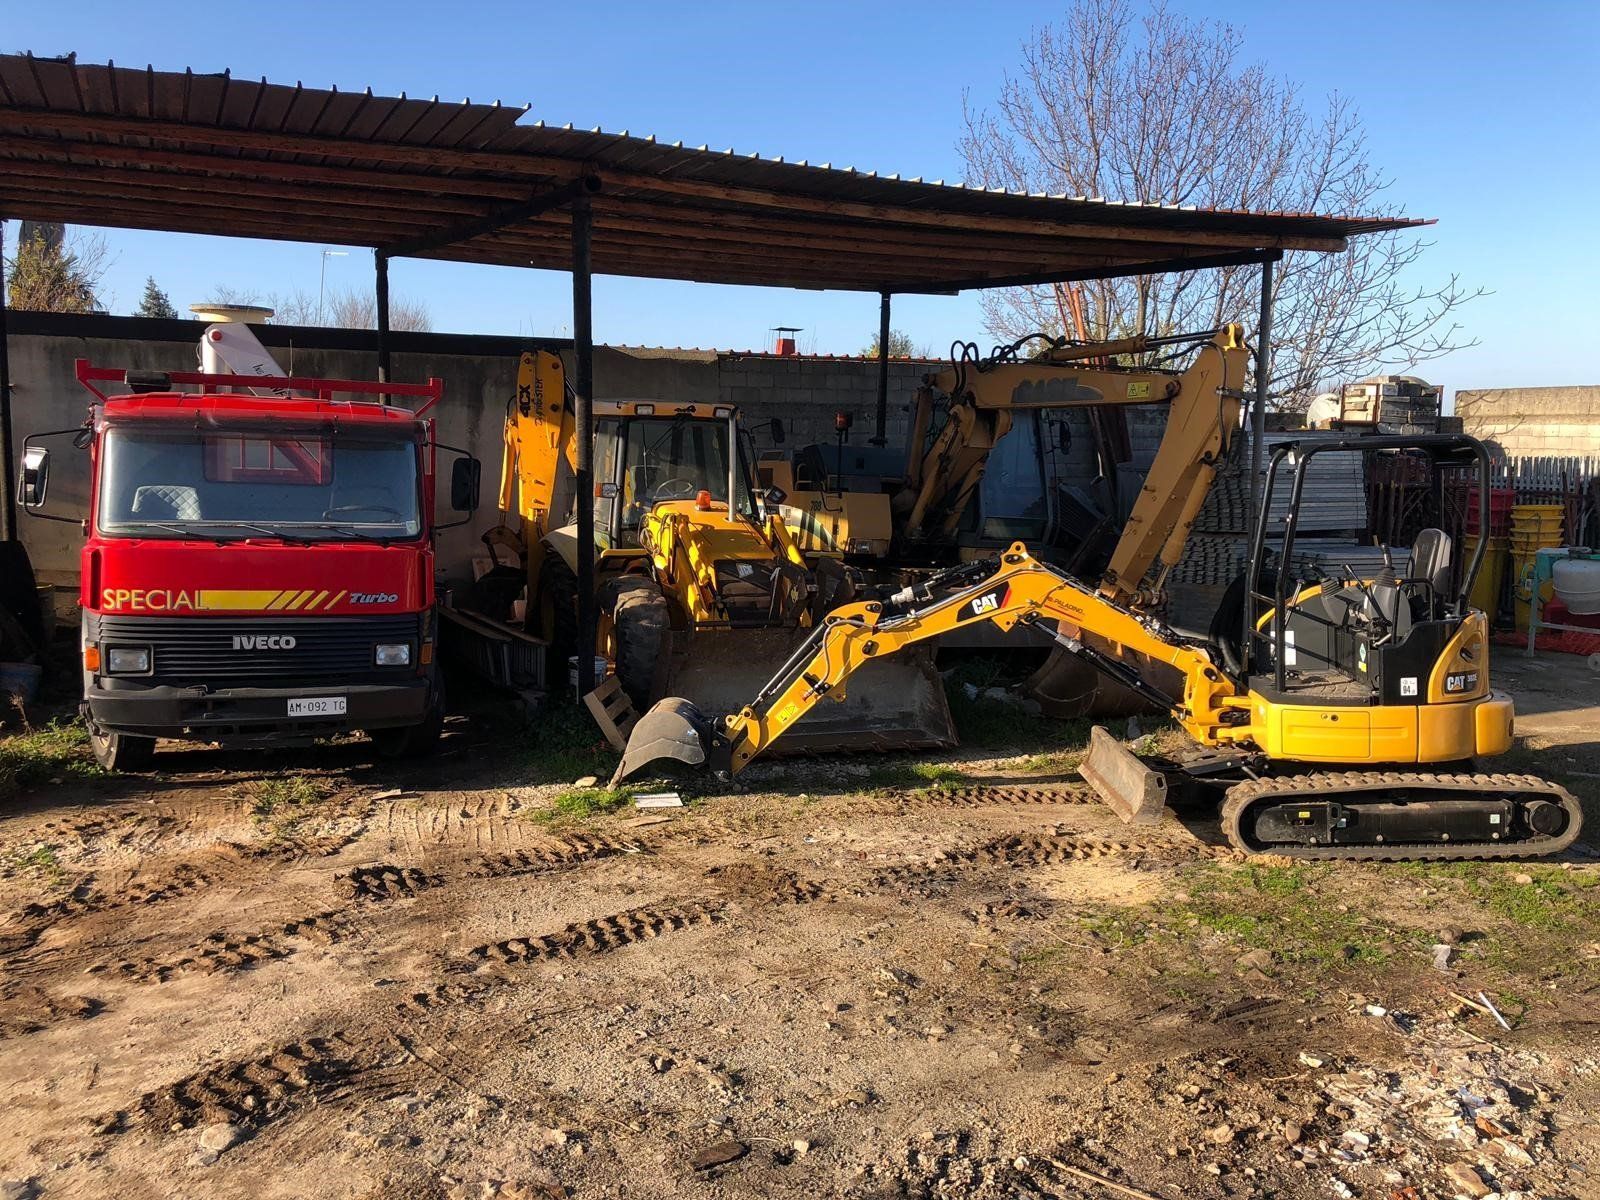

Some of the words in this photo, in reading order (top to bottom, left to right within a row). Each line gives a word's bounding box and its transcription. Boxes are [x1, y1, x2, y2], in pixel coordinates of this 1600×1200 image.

[519, 384, 531, 418] 4CX
[103, 589, 208, 610] SPECIAL
[350, 592, 399, 604] Turbo
[971, 593, 998, 615] CAT
[232, 635, 296, 650] IVECO
[1447, 674, 1465, 691] CAT
[333, 701, 345, 711] TG
